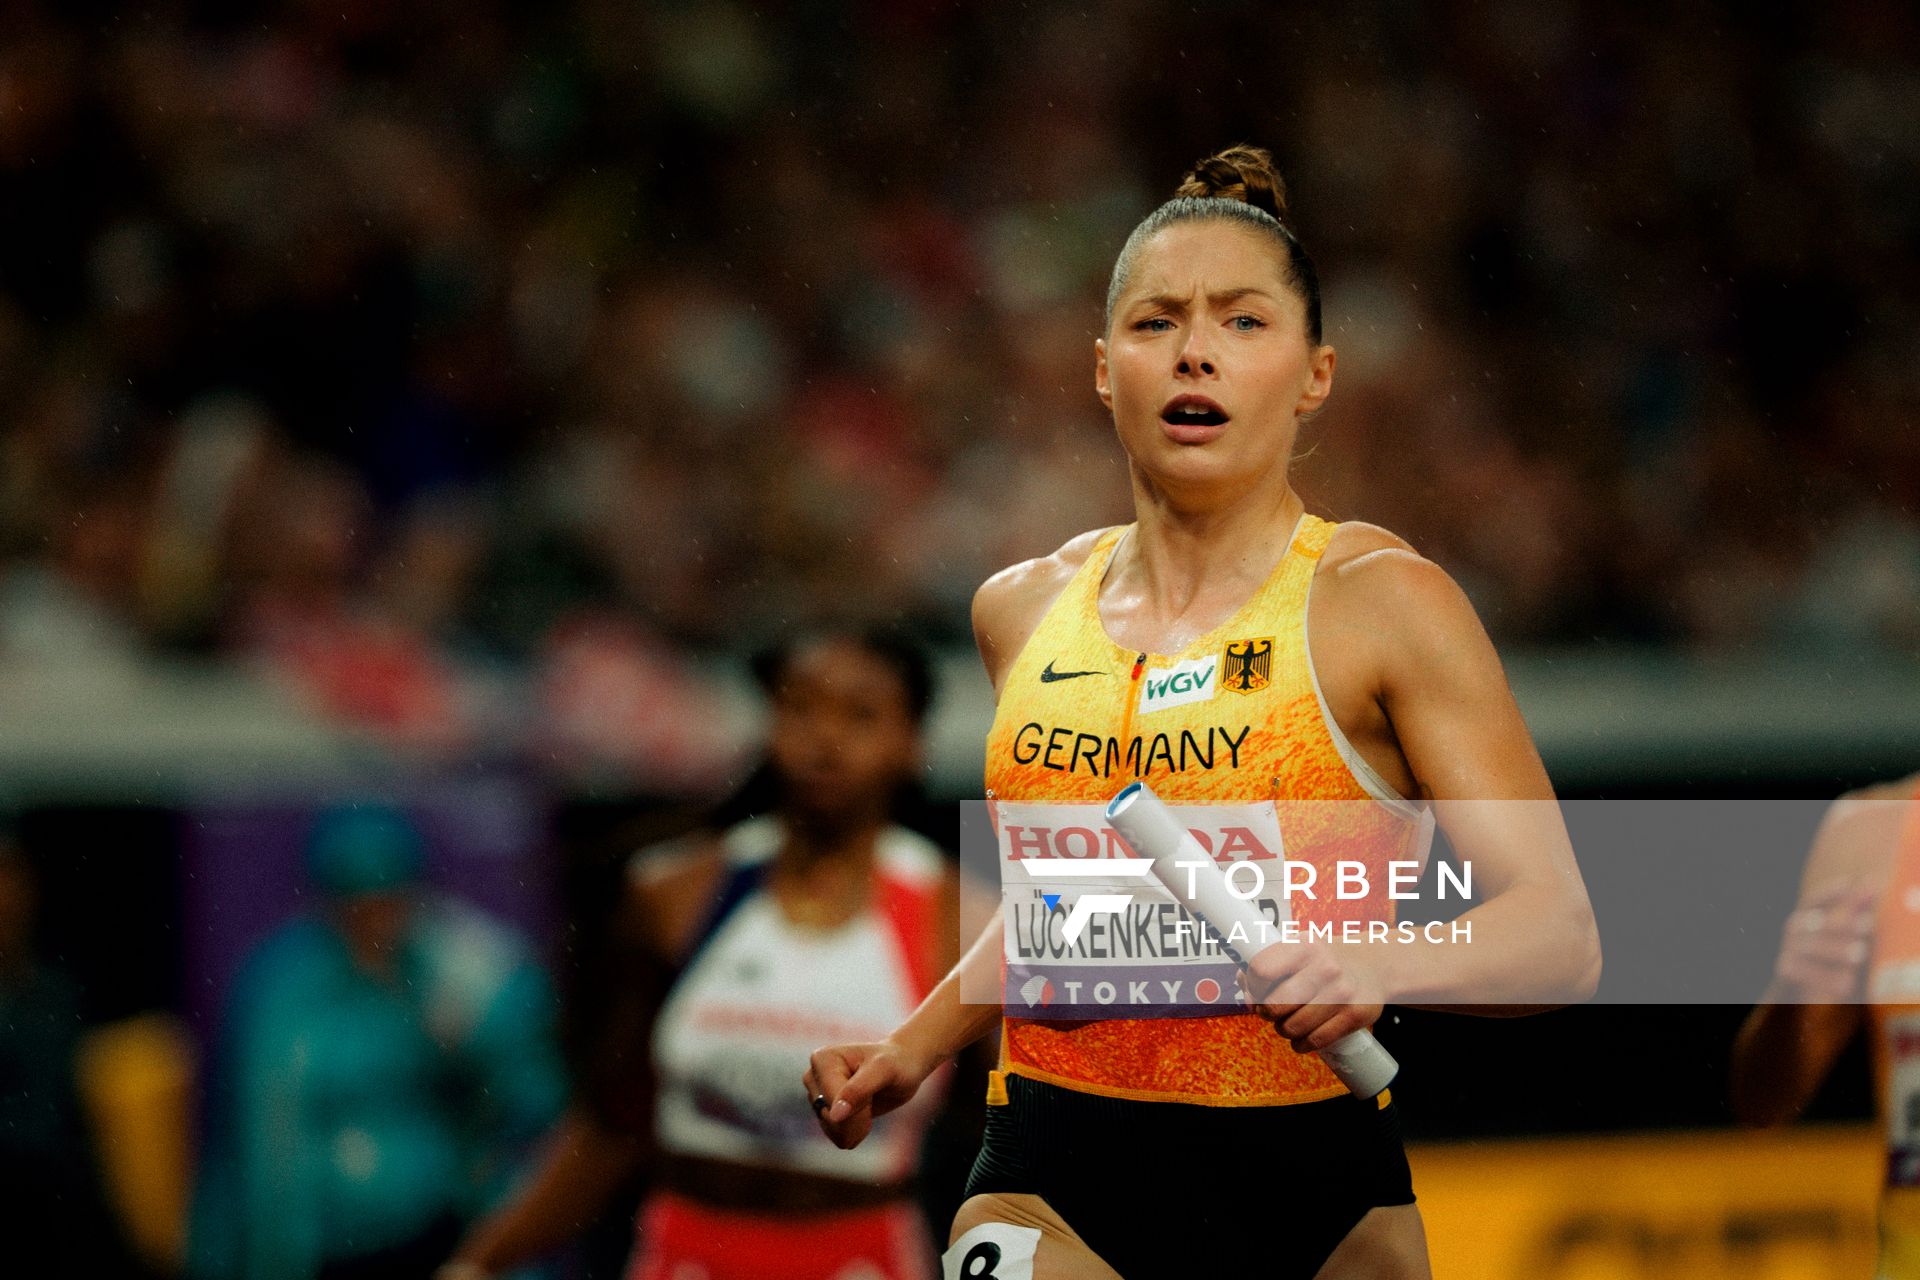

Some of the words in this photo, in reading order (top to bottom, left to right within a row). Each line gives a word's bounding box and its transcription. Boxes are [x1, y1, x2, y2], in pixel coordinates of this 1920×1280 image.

[1146, 665, 1215, 700] WGV
[1013, 722, 1250, 779] GERMANY
[1014, 888, 1280, 960] LÜCENKEM
